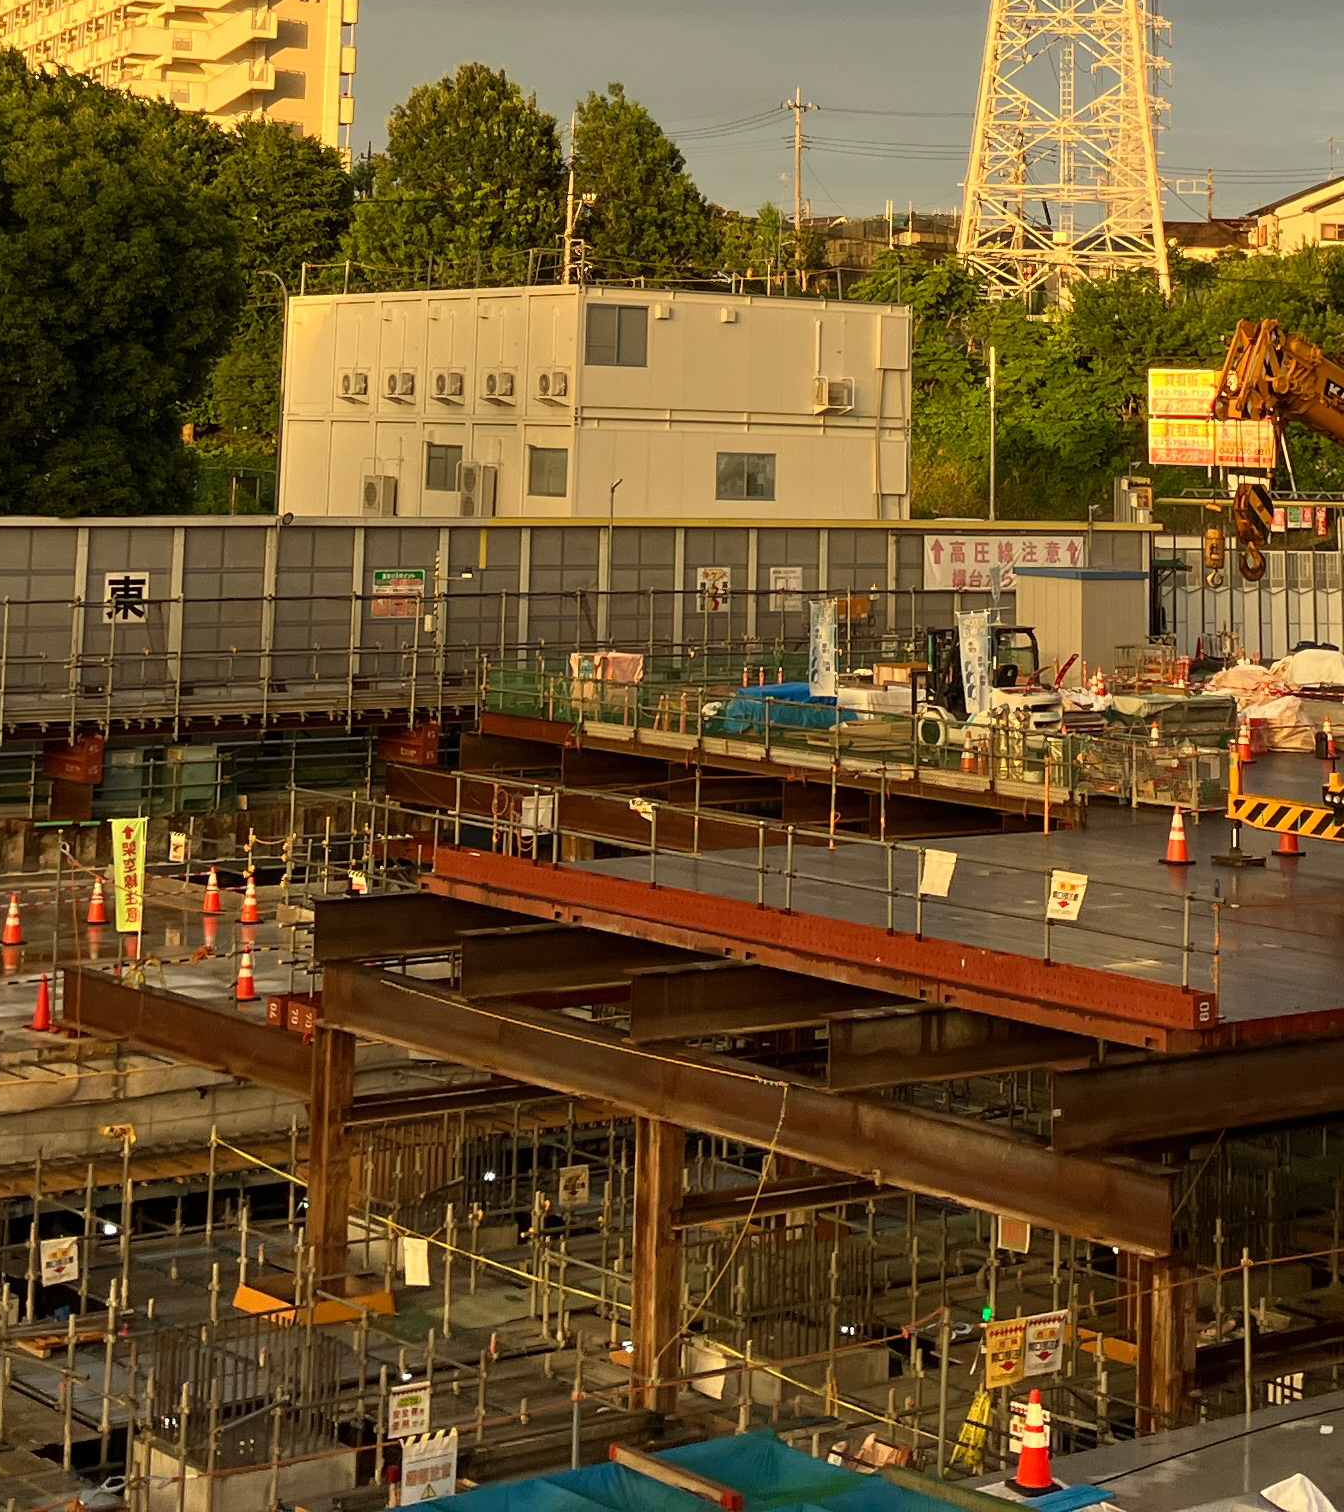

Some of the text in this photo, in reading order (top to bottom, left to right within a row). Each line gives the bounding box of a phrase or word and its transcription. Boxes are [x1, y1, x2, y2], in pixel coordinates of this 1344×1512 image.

[949, 540, 1062, 564] 高圧線注意
[107, 575, 146, 620] 東
[269, 1002, 278, 1019] 70
